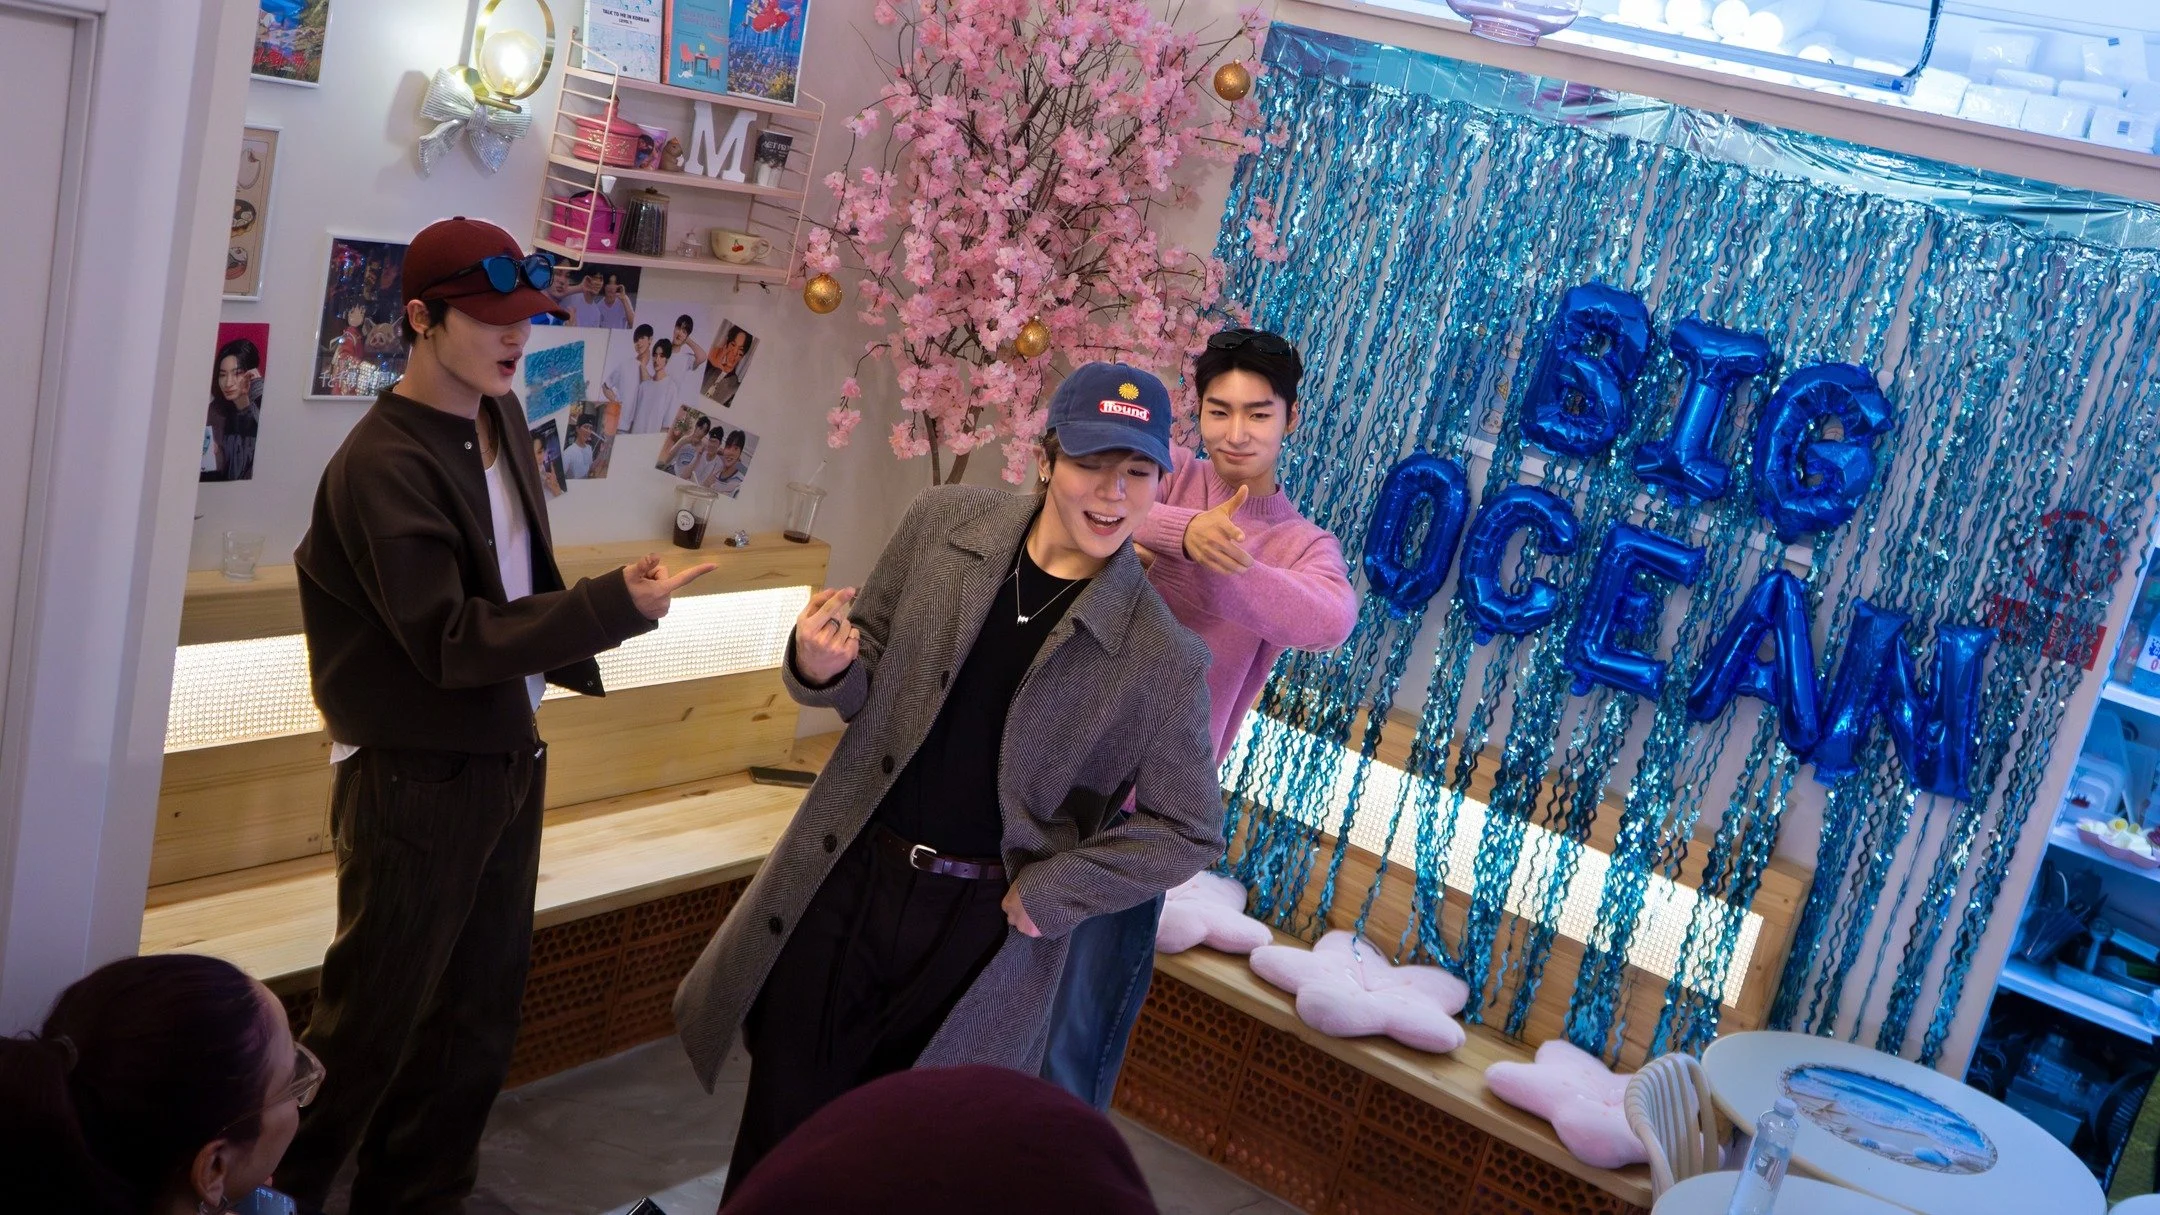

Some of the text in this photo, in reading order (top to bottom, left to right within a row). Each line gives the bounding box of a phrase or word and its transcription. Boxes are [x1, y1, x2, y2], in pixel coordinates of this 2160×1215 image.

[684, 100, 757, 183] M
[1521, 282, 1893, 543] BIG
[1363, 450, 1994, 799] OCEAN
